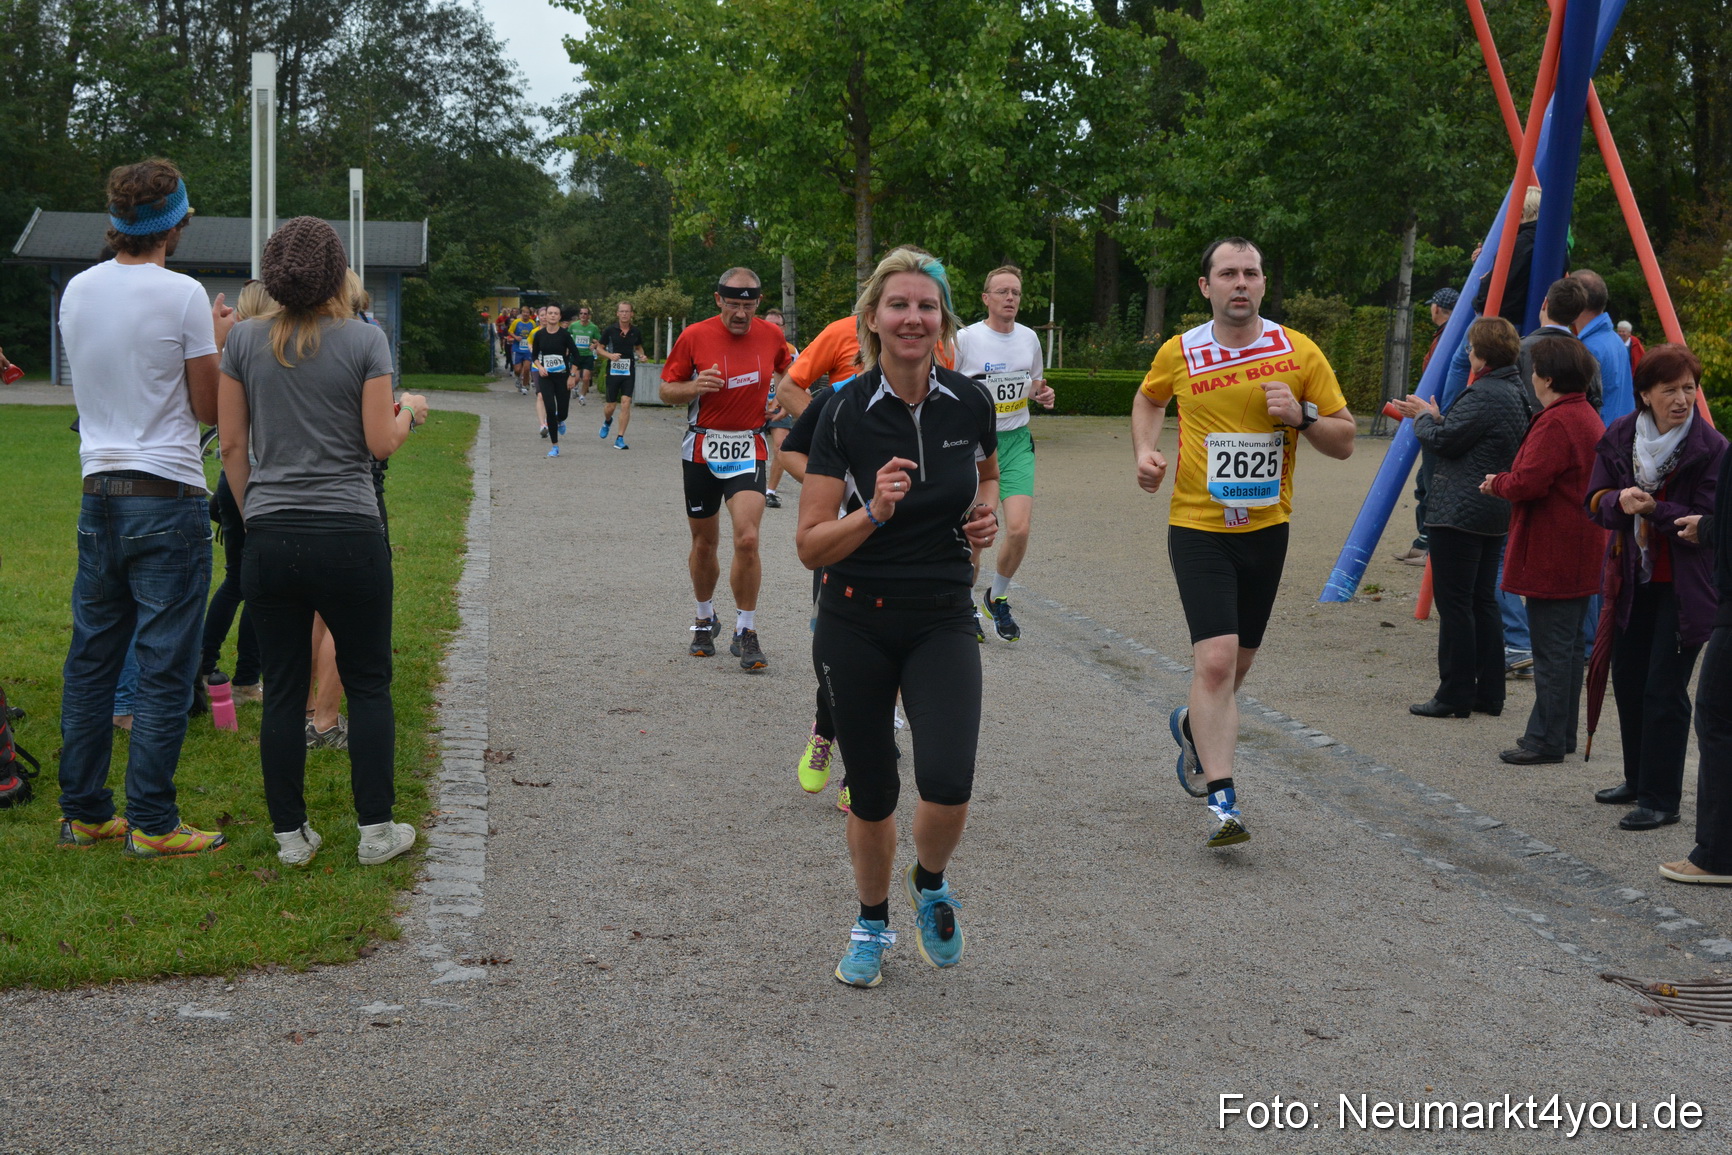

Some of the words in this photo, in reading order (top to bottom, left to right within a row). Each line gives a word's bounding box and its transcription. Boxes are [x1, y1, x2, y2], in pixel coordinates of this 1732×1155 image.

[612, 362, 629, 370] 2892
[1191, 372, 1240, 395] MAX
[1246, 359, 1300, 381] BÖGL
[997, 382, 1025, 401] 637
[708, 441, 751, 459] 2662
[717, 464, 741, 472] Helmut
[1216, 451, 1278, 478] 2625
[1222, 486, 1271, 497] Sebastian
